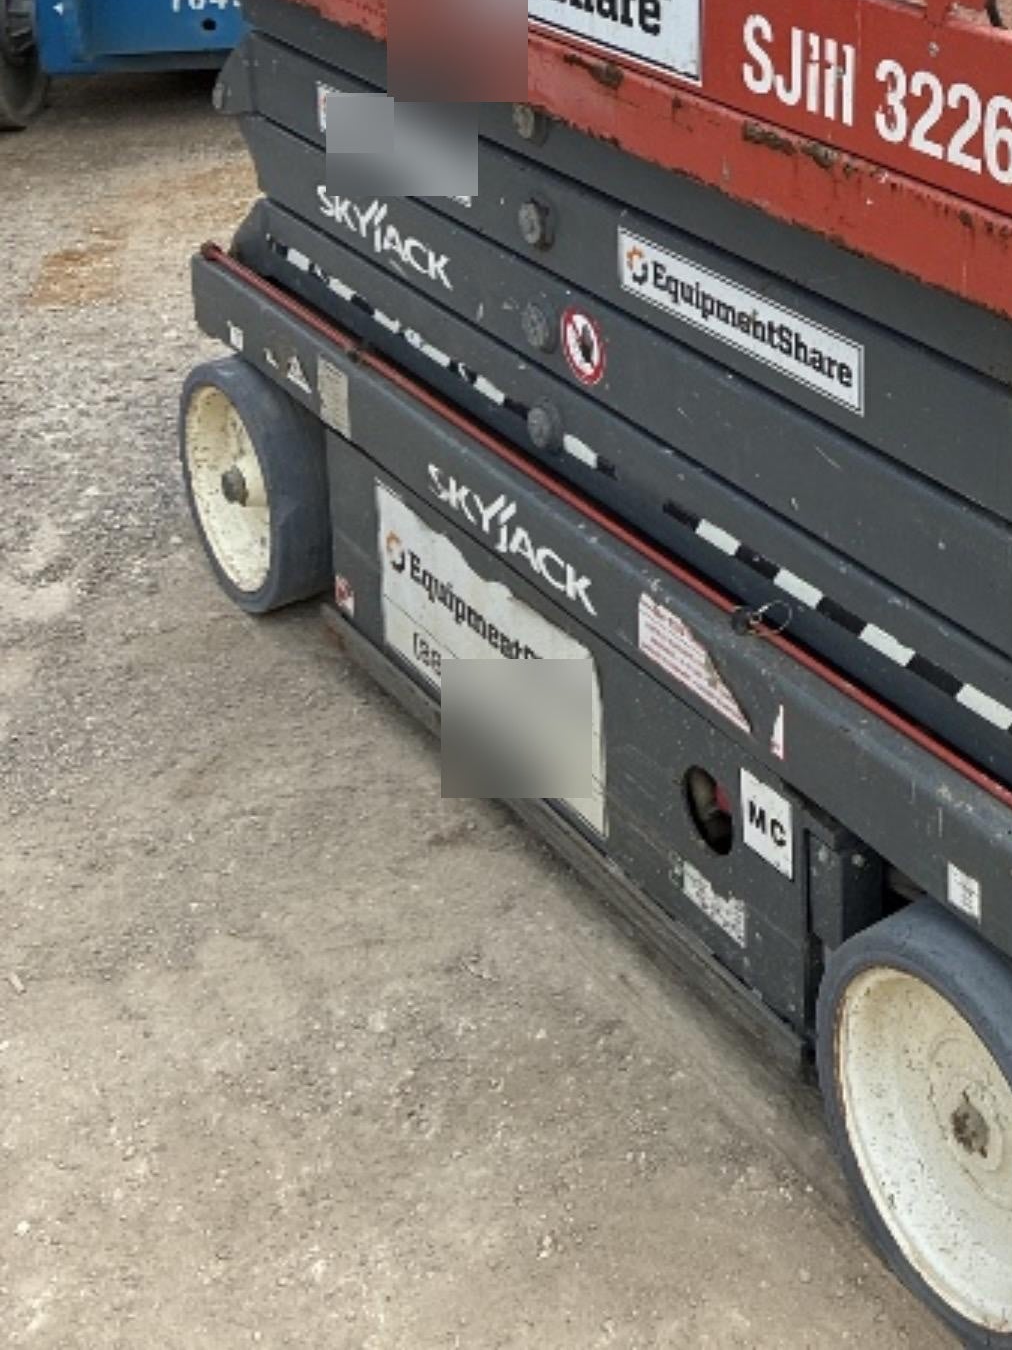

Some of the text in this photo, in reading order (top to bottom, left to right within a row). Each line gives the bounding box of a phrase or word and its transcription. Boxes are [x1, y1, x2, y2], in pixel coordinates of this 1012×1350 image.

[317, 185, 453, 291] SKYJACK
[652, 261, 853, 388] EquipmentShare
[428, 464, 598, 617] SKYJACK
